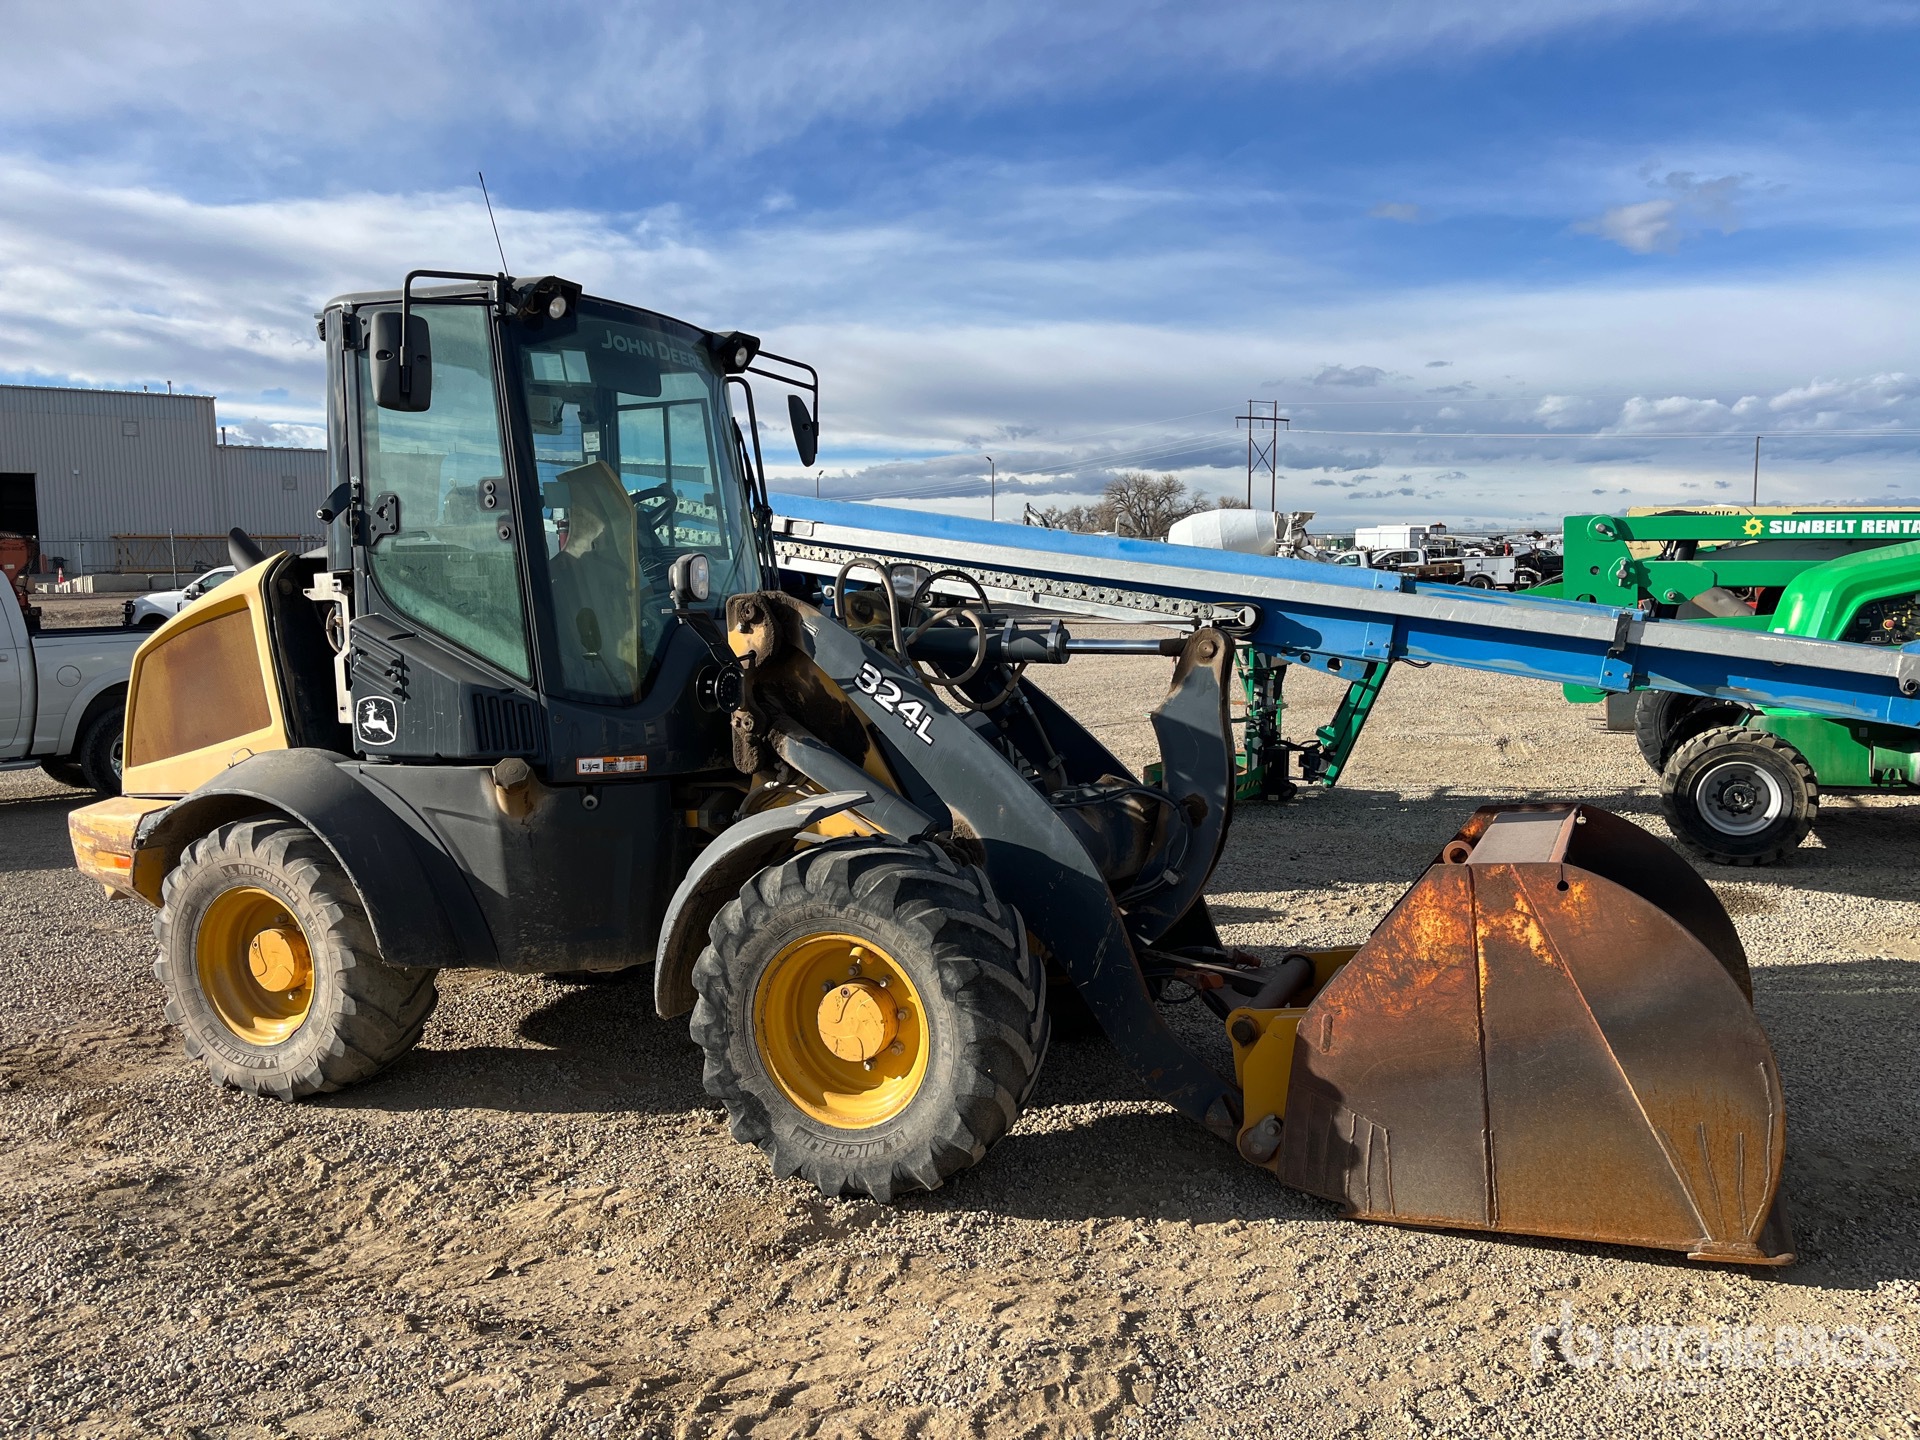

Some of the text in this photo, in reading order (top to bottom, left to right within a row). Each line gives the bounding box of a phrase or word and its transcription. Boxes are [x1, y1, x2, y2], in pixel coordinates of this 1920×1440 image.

[601, 330, 706, 372] JOHN DEERE
[1768, 519, 1857, 534] SUNBELT
[853, 661, 935, 746] 324L
[237, 864, 300, 903] MICHELIN
[790, 904, 882, 932] MICHELIN
[200, 1026, 263, 1069] MICHELIN
[793, 1130, 885, 1159] MICHELIN
